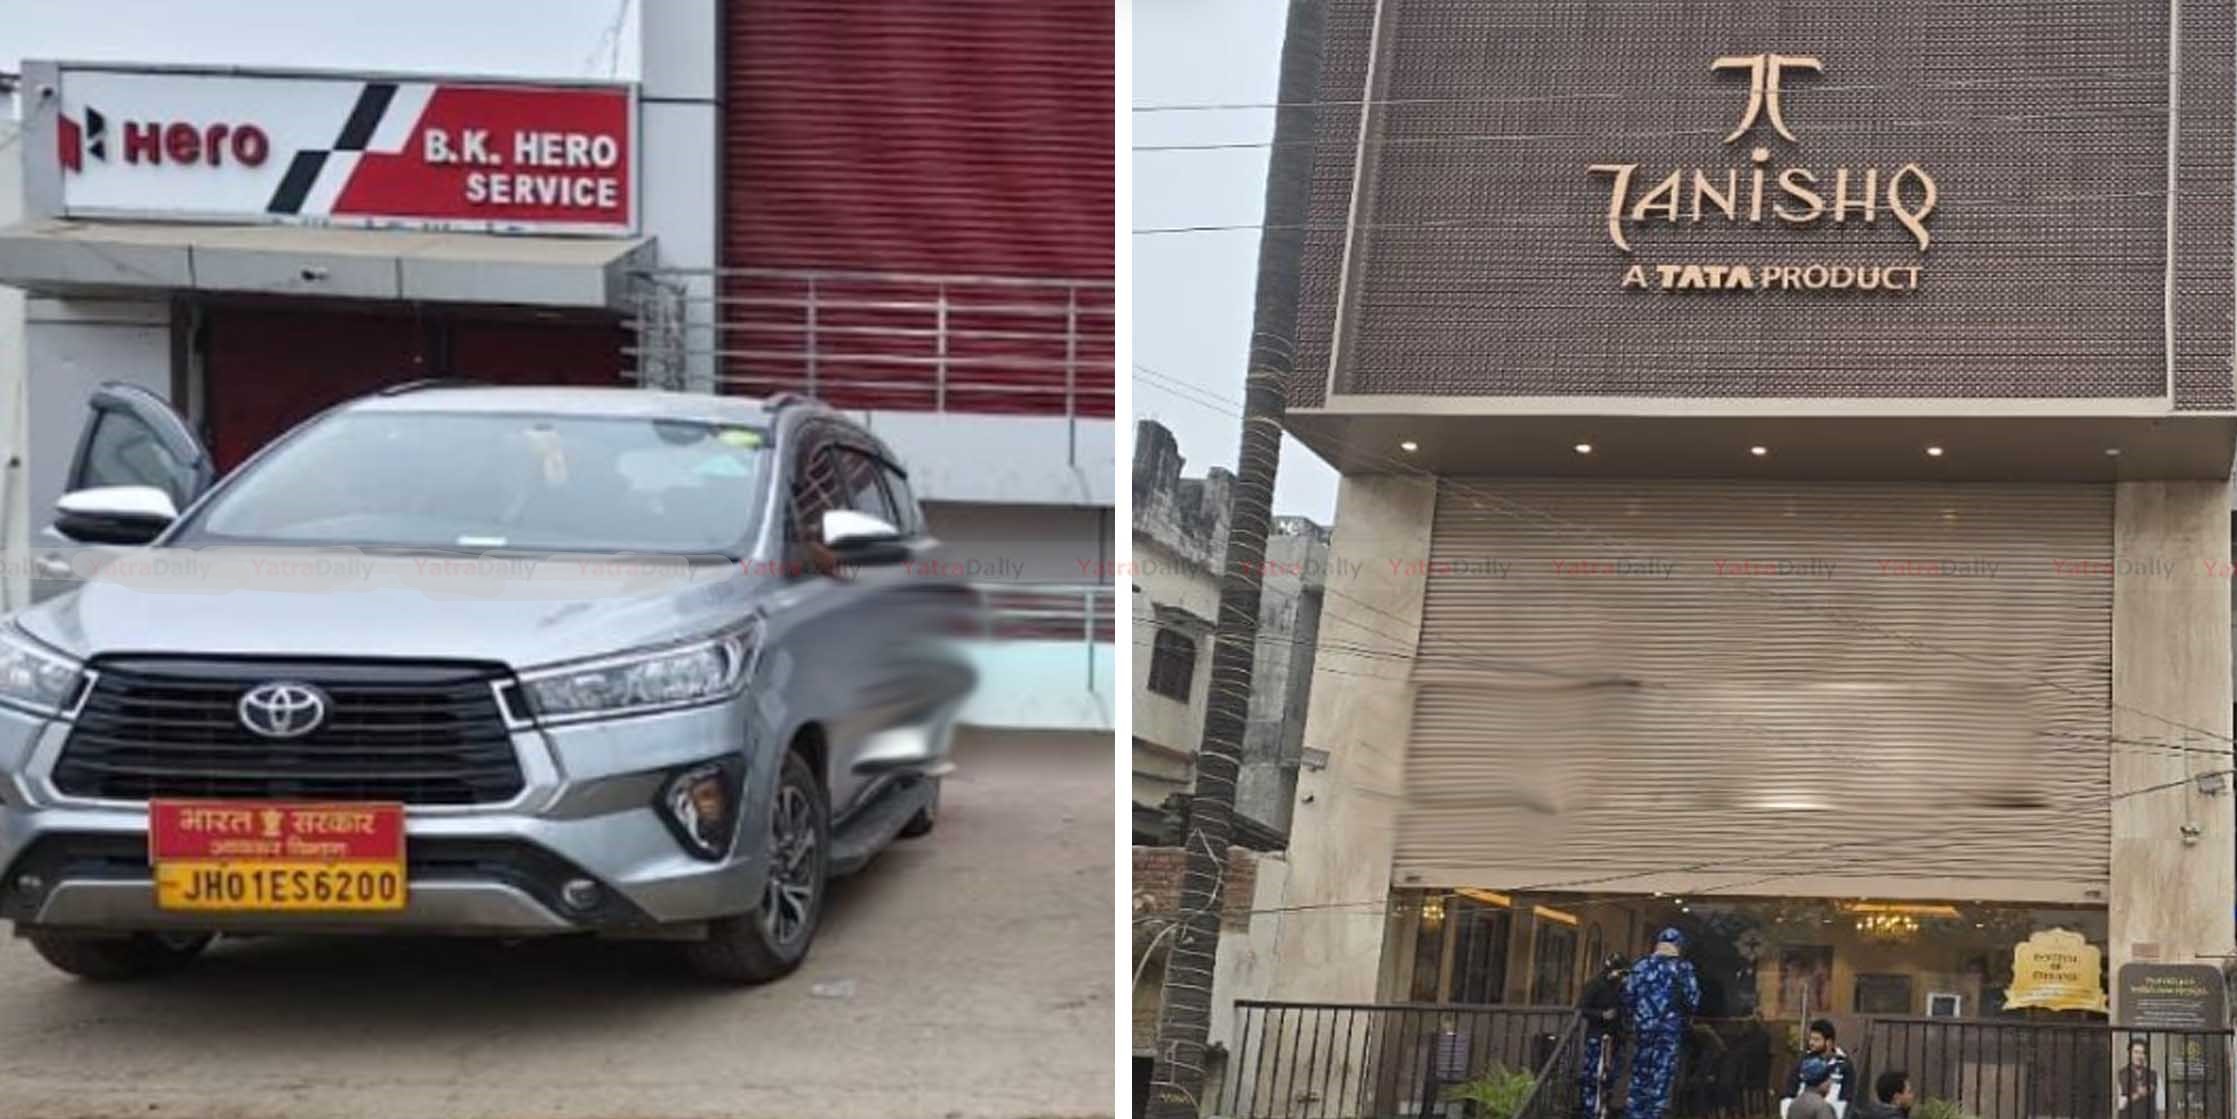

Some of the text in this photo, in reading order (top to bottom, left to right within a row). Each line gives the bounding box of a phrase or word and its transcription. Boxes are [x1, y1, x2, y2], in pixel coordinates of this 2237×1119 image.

[123, 119, 270, 168] Hero
[424, 128, 618, 169] B.K. HERO
[466, 173, 618, 208] SERVICE
[1621, 264, 1923, 289] A TATA PRODUCT
[179, 809, 375, 835] भारत सरकार
[184, 870, 397, 901] JH01ES6200
